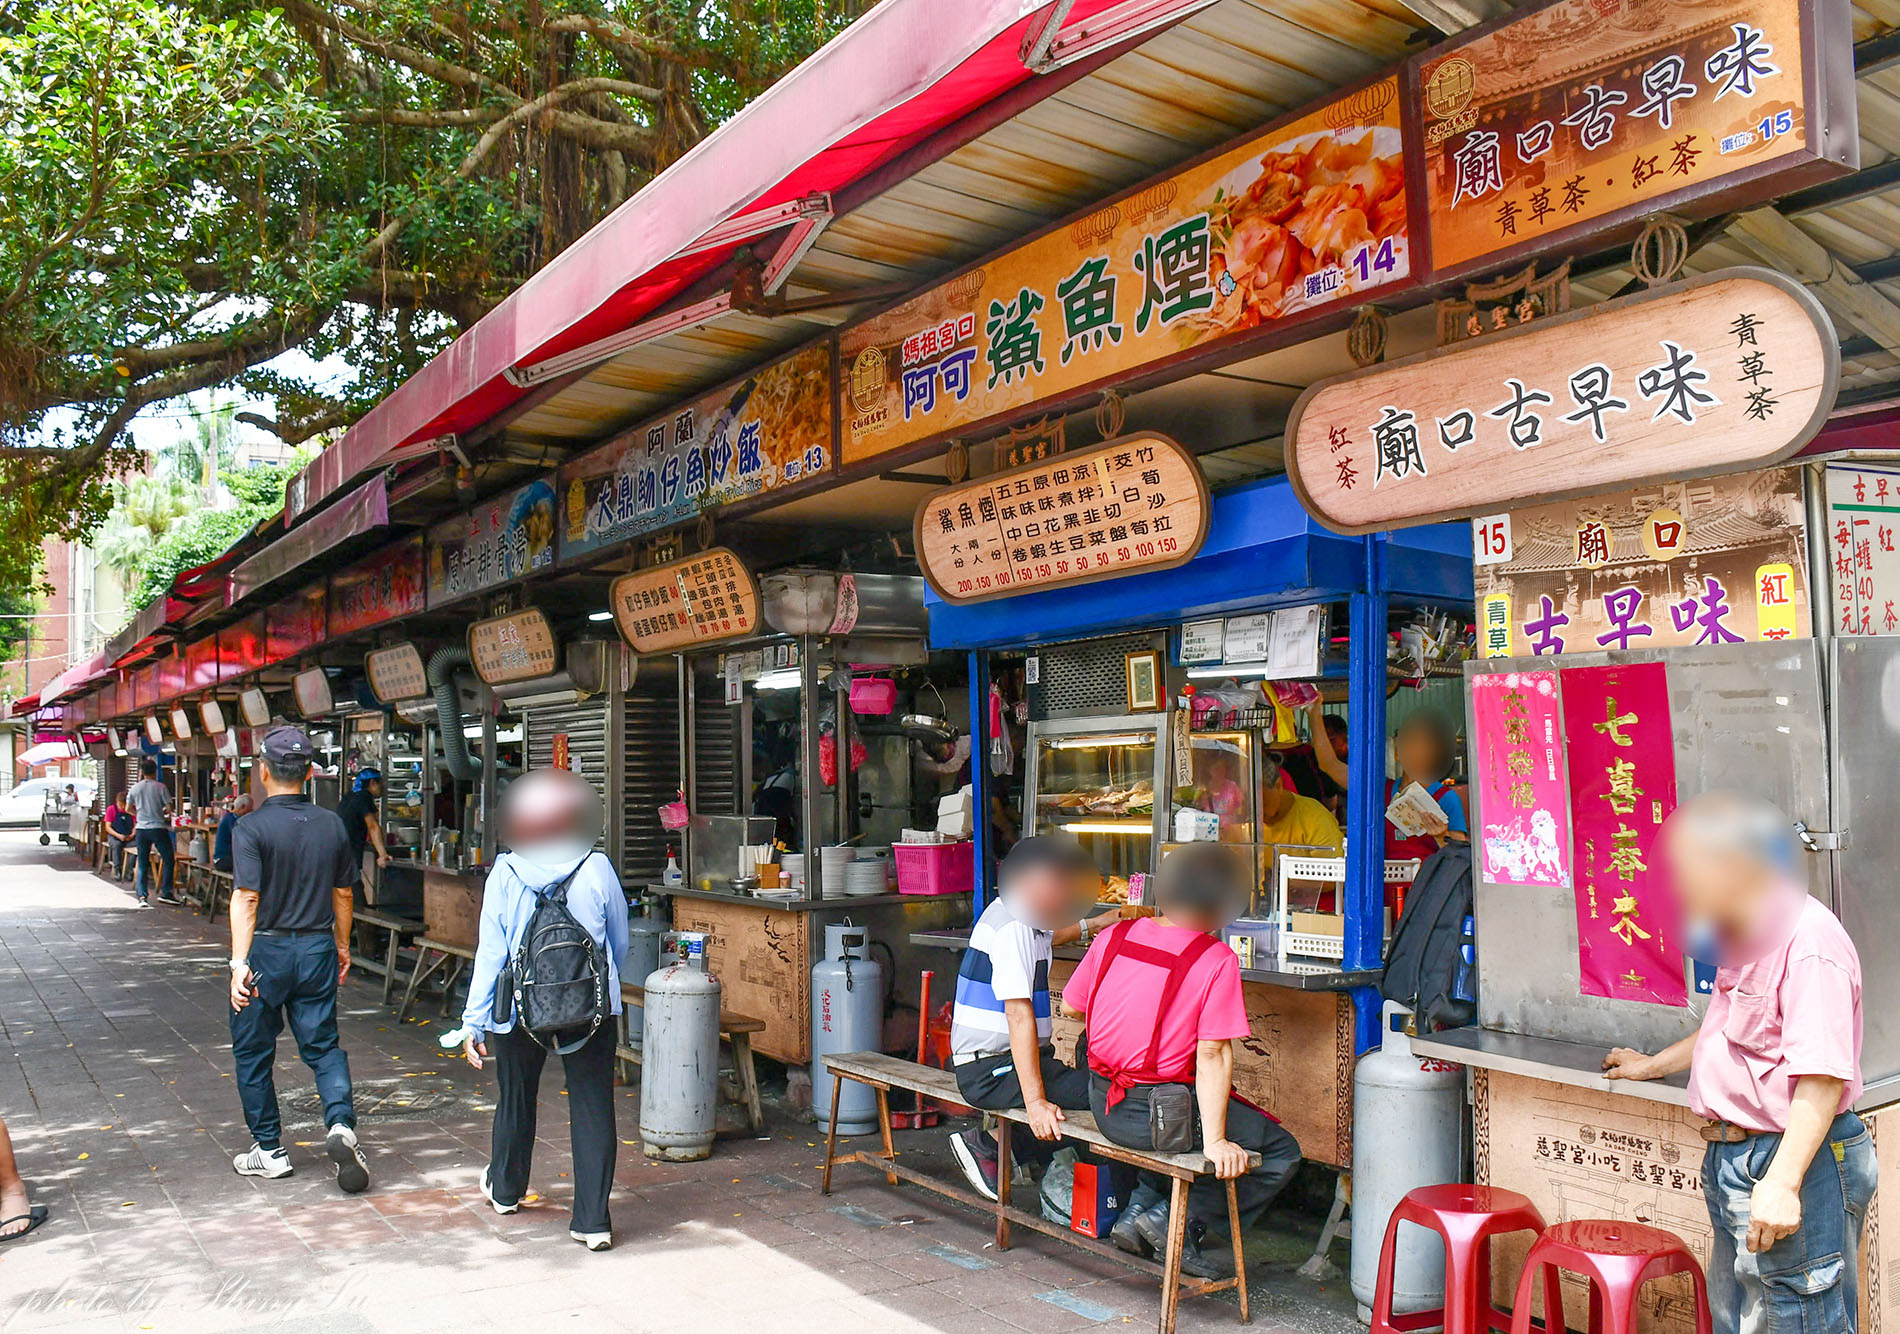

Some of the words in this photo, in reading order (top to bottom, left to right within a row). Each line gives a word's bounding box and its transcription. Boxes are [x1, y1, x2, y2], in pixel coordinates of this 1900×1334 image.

[1451, 23, 1779, 210] 廟口古早味
[1758, 109, 1792, 140] 15
[1353, 237, 1396, 285] 14
[987, 213, 1213, 388] 鯊魚煙
[903, 315, 974, 364] 媽祖宮口
[1726, 311, 1779, 423] 青草茶
[903, 347, 976, 420] 阿可
[648, 409, 694, 456] 阿蘭
[1368, 340, 1720, 490] 廟口古早味
[745, 478, 762, 493] Rice
[805, 446, 823, 472] 13
[1327, 424, 1360, 491] 紅茶
[938, 496, 996, 534] 鯊魚煙
[1053, 470, 1086, 551] 佃煮黑豆
[1077, 557, 1088, 570] 50
[1113, 452, 1149, 535] 茭白筍
[1136, 542, 1154, 557] 100
[1136, 447, 1172, 533] 竹筍沙拉
[1158, 538, 1177, 552] 150
[1853, 473, 1900, 505] 古早
[996, 484, 1027, 562] 五味中卷
[1017, 567, 1032, 581] 150
[1014, 480, 1047, 559] 五味白蝦
[1035, 564, 1051, 578] 150
[1033, 475, 1066, 555] 原味花生
[1057, 560, 1068, 574] 50
[1118, 547, 1130, 561] 50
[1479, 523, 1506, 556] 15
[950, 544, 964, 568] 大份
[958, 579, 972, 592] 200
[968, 539, 983, 564] 兩人
[976, 576, 991, 588] 150
[987, 538, 1001, 560] 一份
[995, 572, 1010, 585] 100
[1097, 552, 1109, 566] 50
[1833, 520, 1857, 634] 每杯25元
[1854, 519, 1877, 635] 一罐40元
[1878, 524, 1898, 632] 紅茶
[1487, 601, 1509, 659] 青草
[1524, 578, 1745, 656] 古早味
[1536, 1136, 1620, 1172] 慈聖宮小吃
